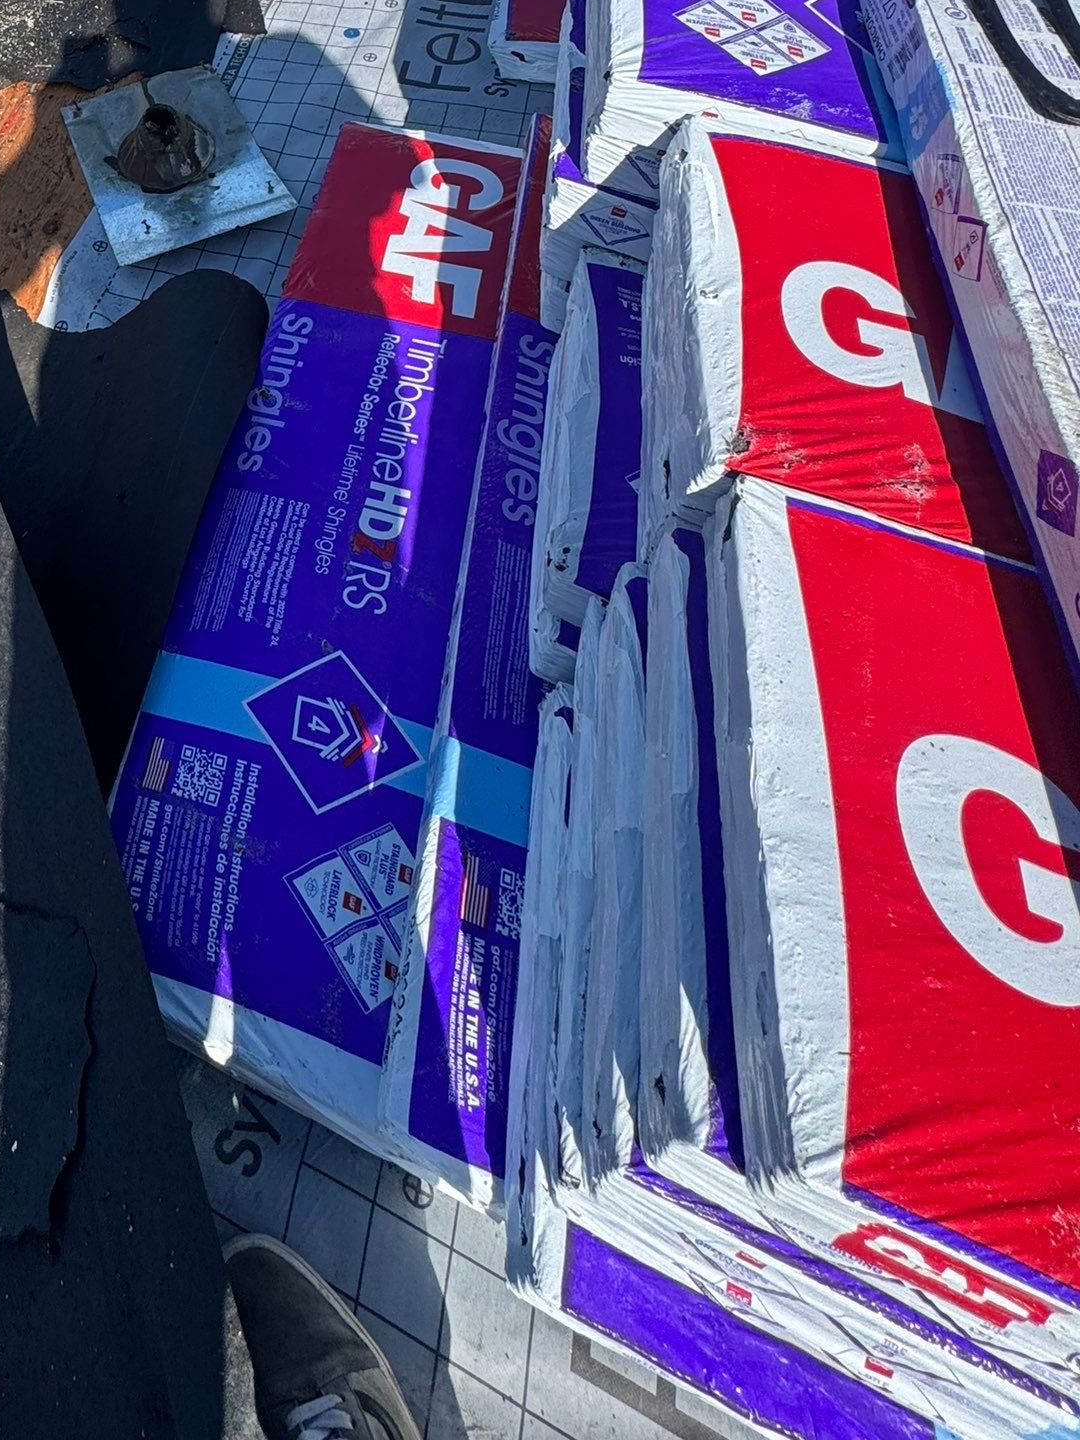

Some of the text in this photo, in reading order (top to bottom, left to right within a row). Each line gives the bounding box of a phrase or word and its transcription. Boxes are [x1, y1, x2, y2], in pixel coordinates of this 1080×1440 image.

[381, 157, 504, 319] GAF
[367, 332, 399, 393] Reflector
[236, 313, 314, 473] Shingles
[492, 331, 555, 527] Shingles
[313, 503, 348, 578] Shingles
[143, 799, 159, 836] MADE
[236, 763, 260, 839] Installation
[138, 839, 150, 854] IN
[206, 759, 245, 961] Instrucciones de instalación
[133, 857, 146, 883] THE
[383, 842, 401, 895] STAINGUARD
[454, 928, 463, 969] AMERICAN
[451, 971, 460, 992] JOBS
[459, 951, 469, 992] DOMESTIC
[450, 993, 458, 1003] IN
[457, 993, 466, 1010] AND
[448, 1005, 458, 1048] AMERICAN
[455, 1012, 465, 1051] IMPORTED
[464, 937, 485, 1113] MADE IN THE U.S.A.
